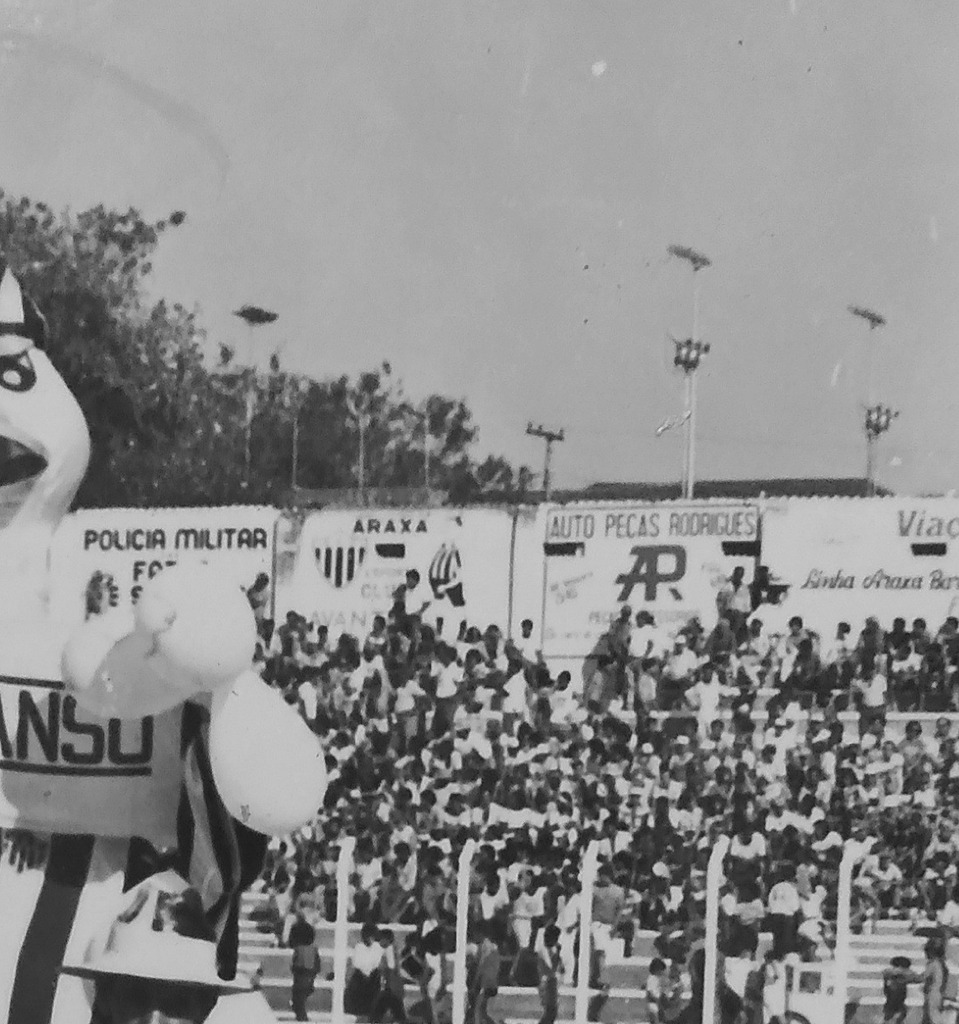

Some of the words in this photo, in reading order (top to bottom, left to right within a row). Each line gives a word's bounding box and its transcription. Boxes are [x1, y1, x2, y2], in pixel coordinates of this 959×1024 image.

[550, 514, 595, 539] AUTO
[669, 511, 756, 536] RODRIGUES
[84, 529, 166, 551] POLICIA
[174, 528, 268, 550] MILITAR
[800, 568, 855, 590] Linha
